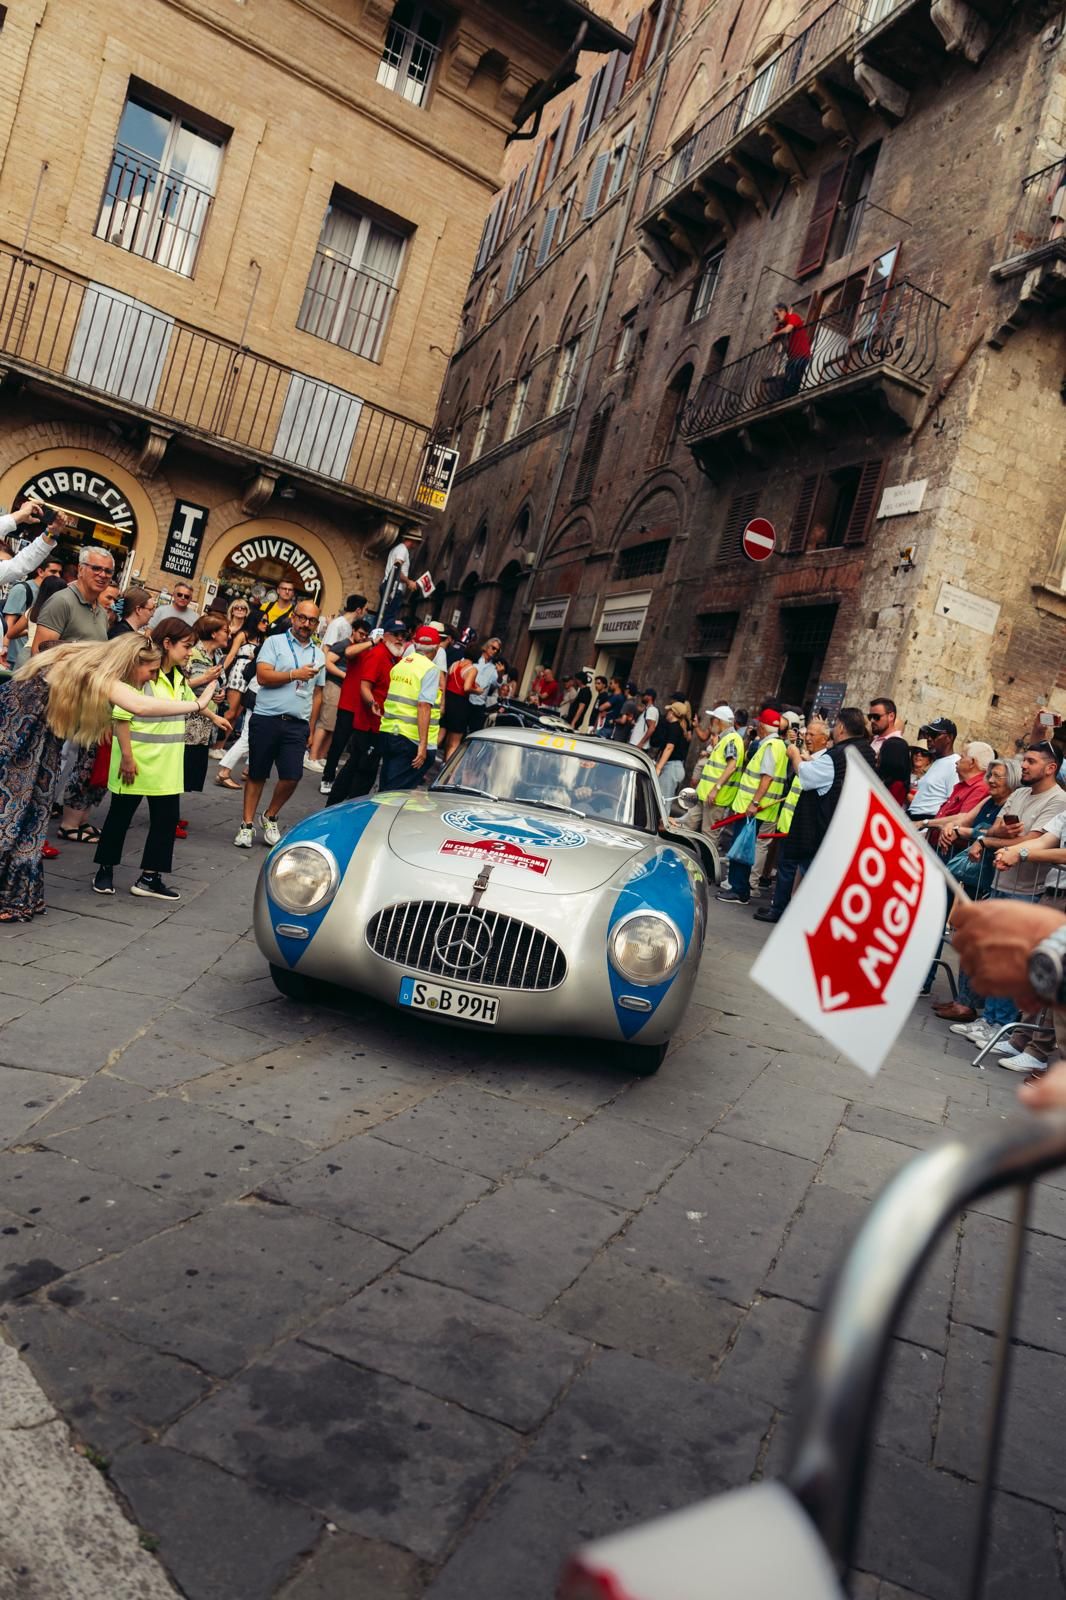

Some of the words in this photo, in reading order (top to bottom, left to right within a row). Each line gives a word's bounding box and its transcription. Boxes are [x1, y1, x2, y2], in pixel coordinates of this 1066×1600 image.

[23, 472, 133, 528] TABACCHI
[180, 505, 203, 545] T
[165, 562, 192, 574] BOLLATI
[168, 554, 192, 568] VALORI
[170, 547, 195, 560] TABACCHI
[231, 540, 321, 592] SOUVENIRS
[454, 844, 488, 854] CARRERA
[488, 850, 545, 868] PANAMERICANA
[829, 812, 896, 944] 1000
[858, 836, 925, 990] MIGLIA
[457, 994, 497, 1021] 99H
